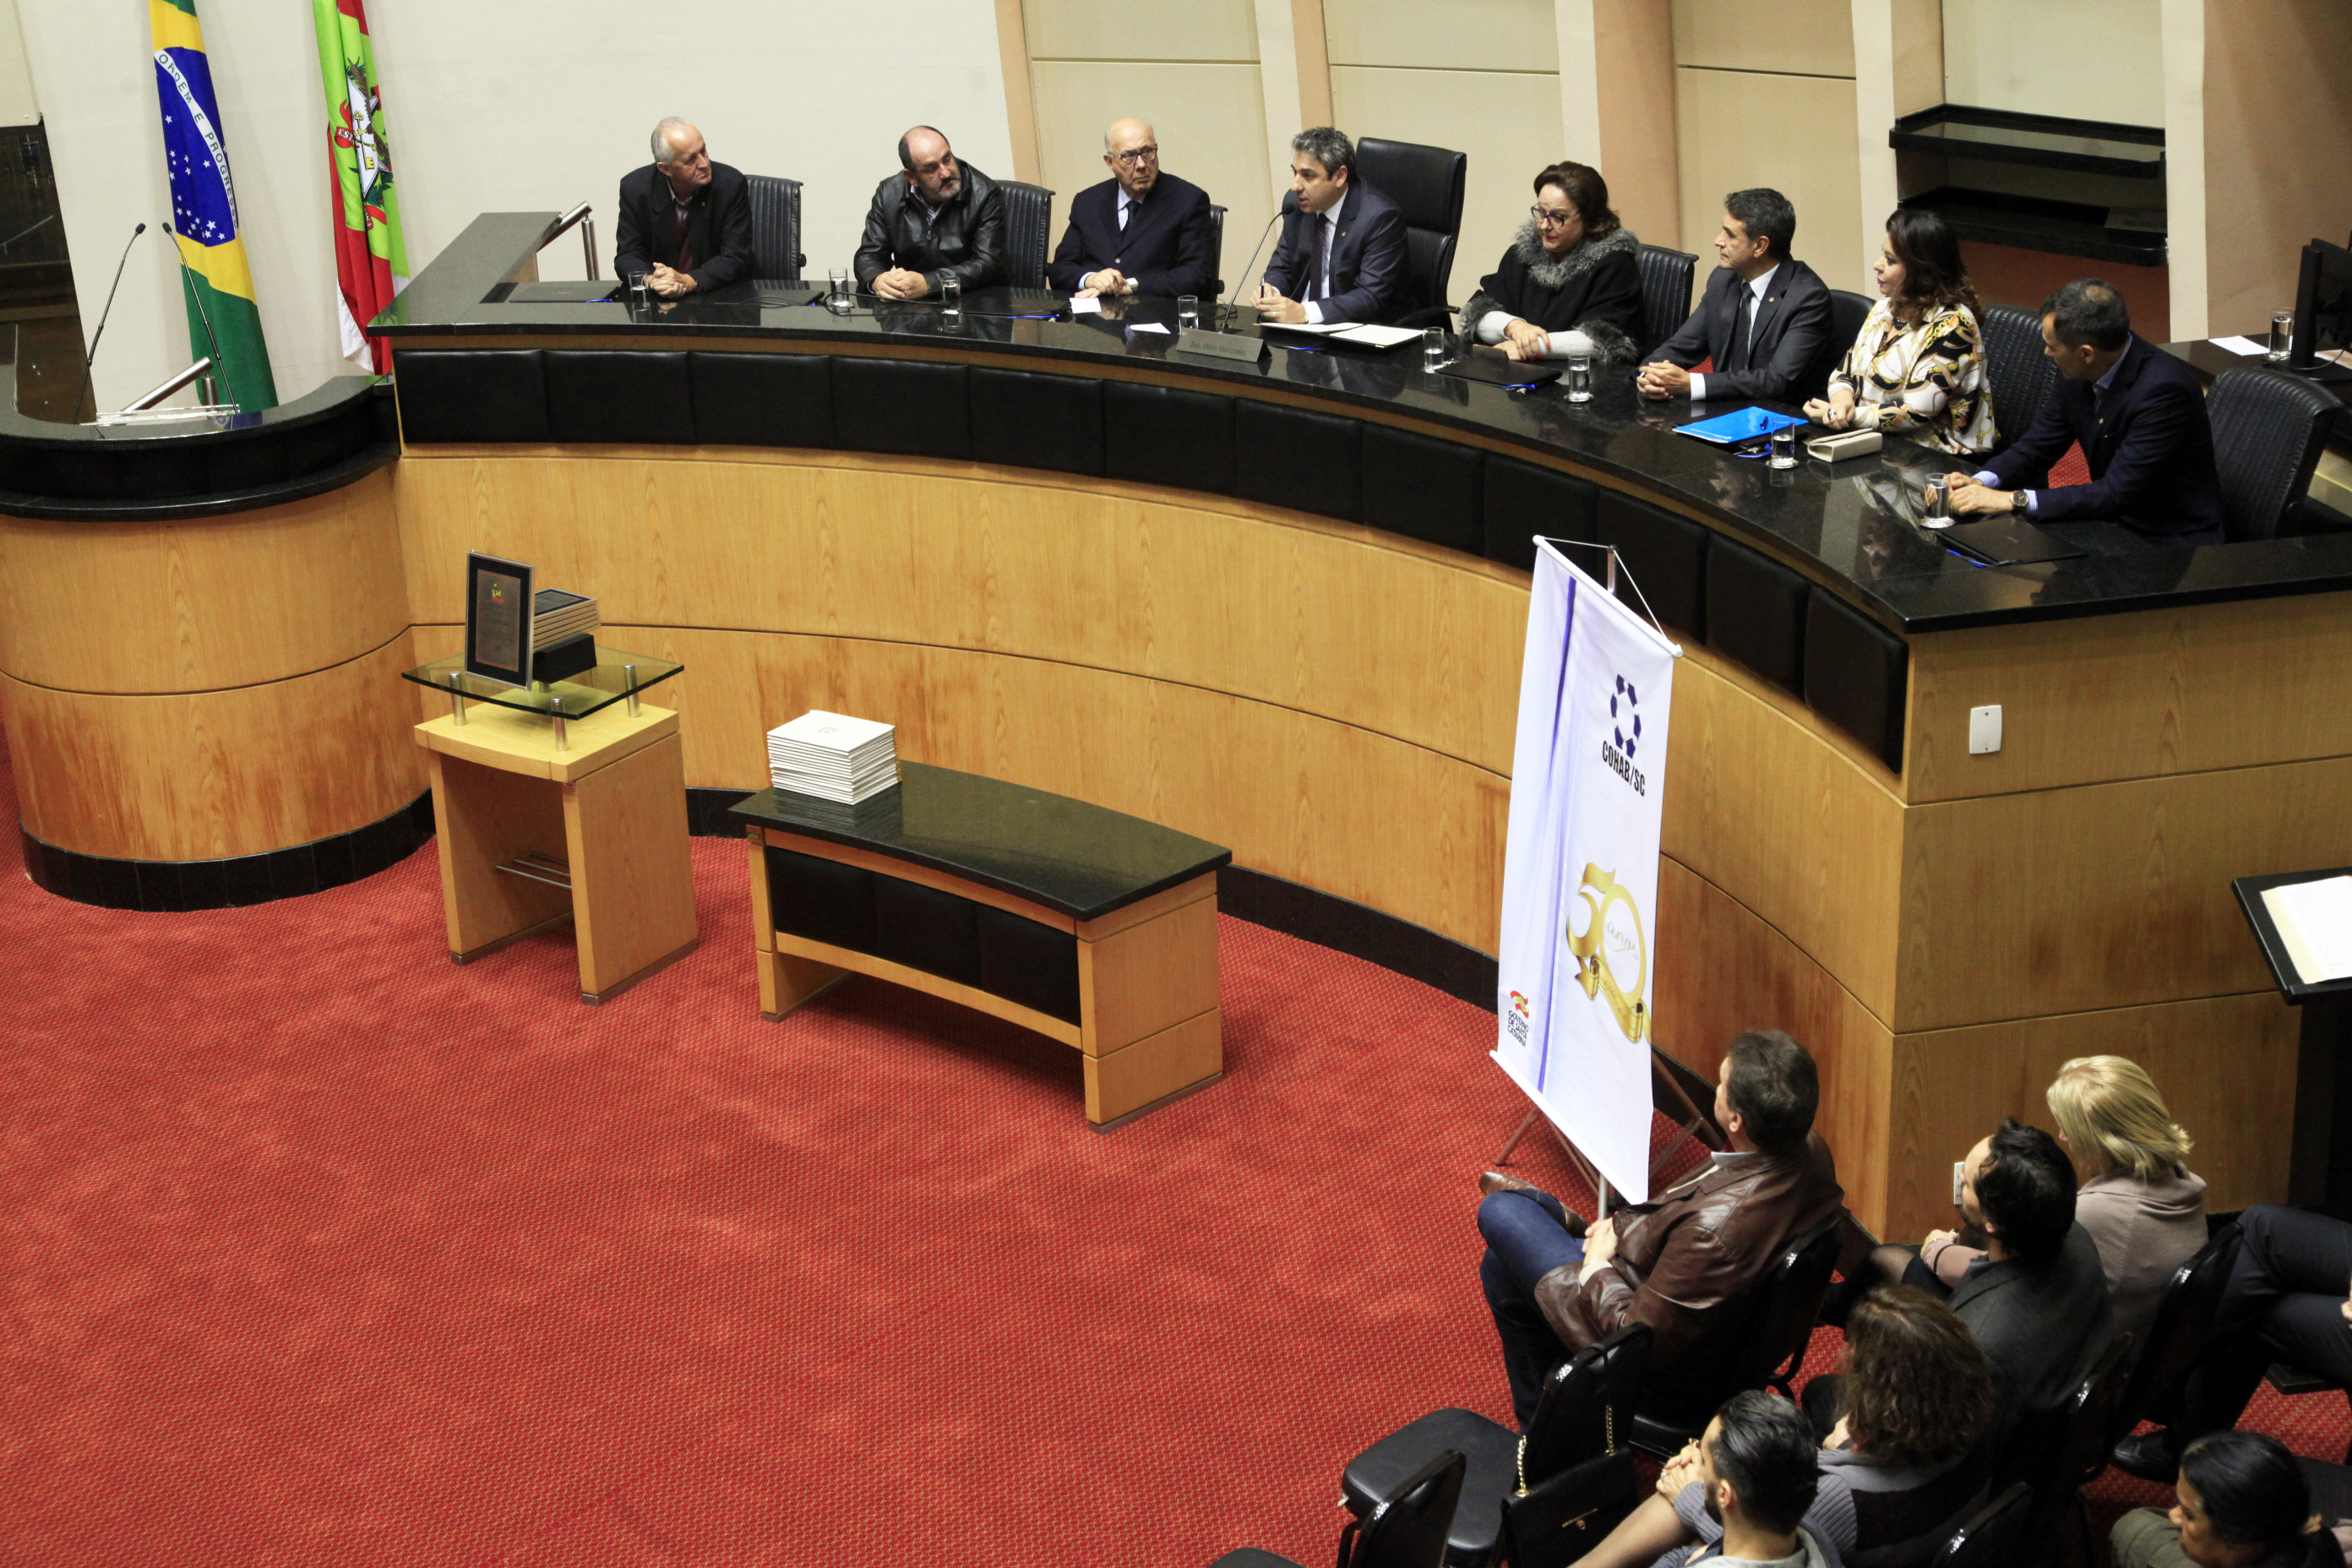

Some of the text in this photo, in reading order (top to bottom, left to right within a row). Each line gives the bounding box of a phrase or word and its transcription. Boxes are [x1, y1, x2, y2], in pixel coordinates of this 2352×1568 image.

[159, 54, 192, 103] ORDEM
[194, 113, 204, 123] E
[1603, 740, 1645, 797] COHAB/SC
[1566, 863, 1647, 1010] 50
[1507, 1025, 1526, 1047] CATARINA
[1508, 1010, 1528, 1032] GOVERNO
[1508, 1017, 1527, 1040] DE SANTA
